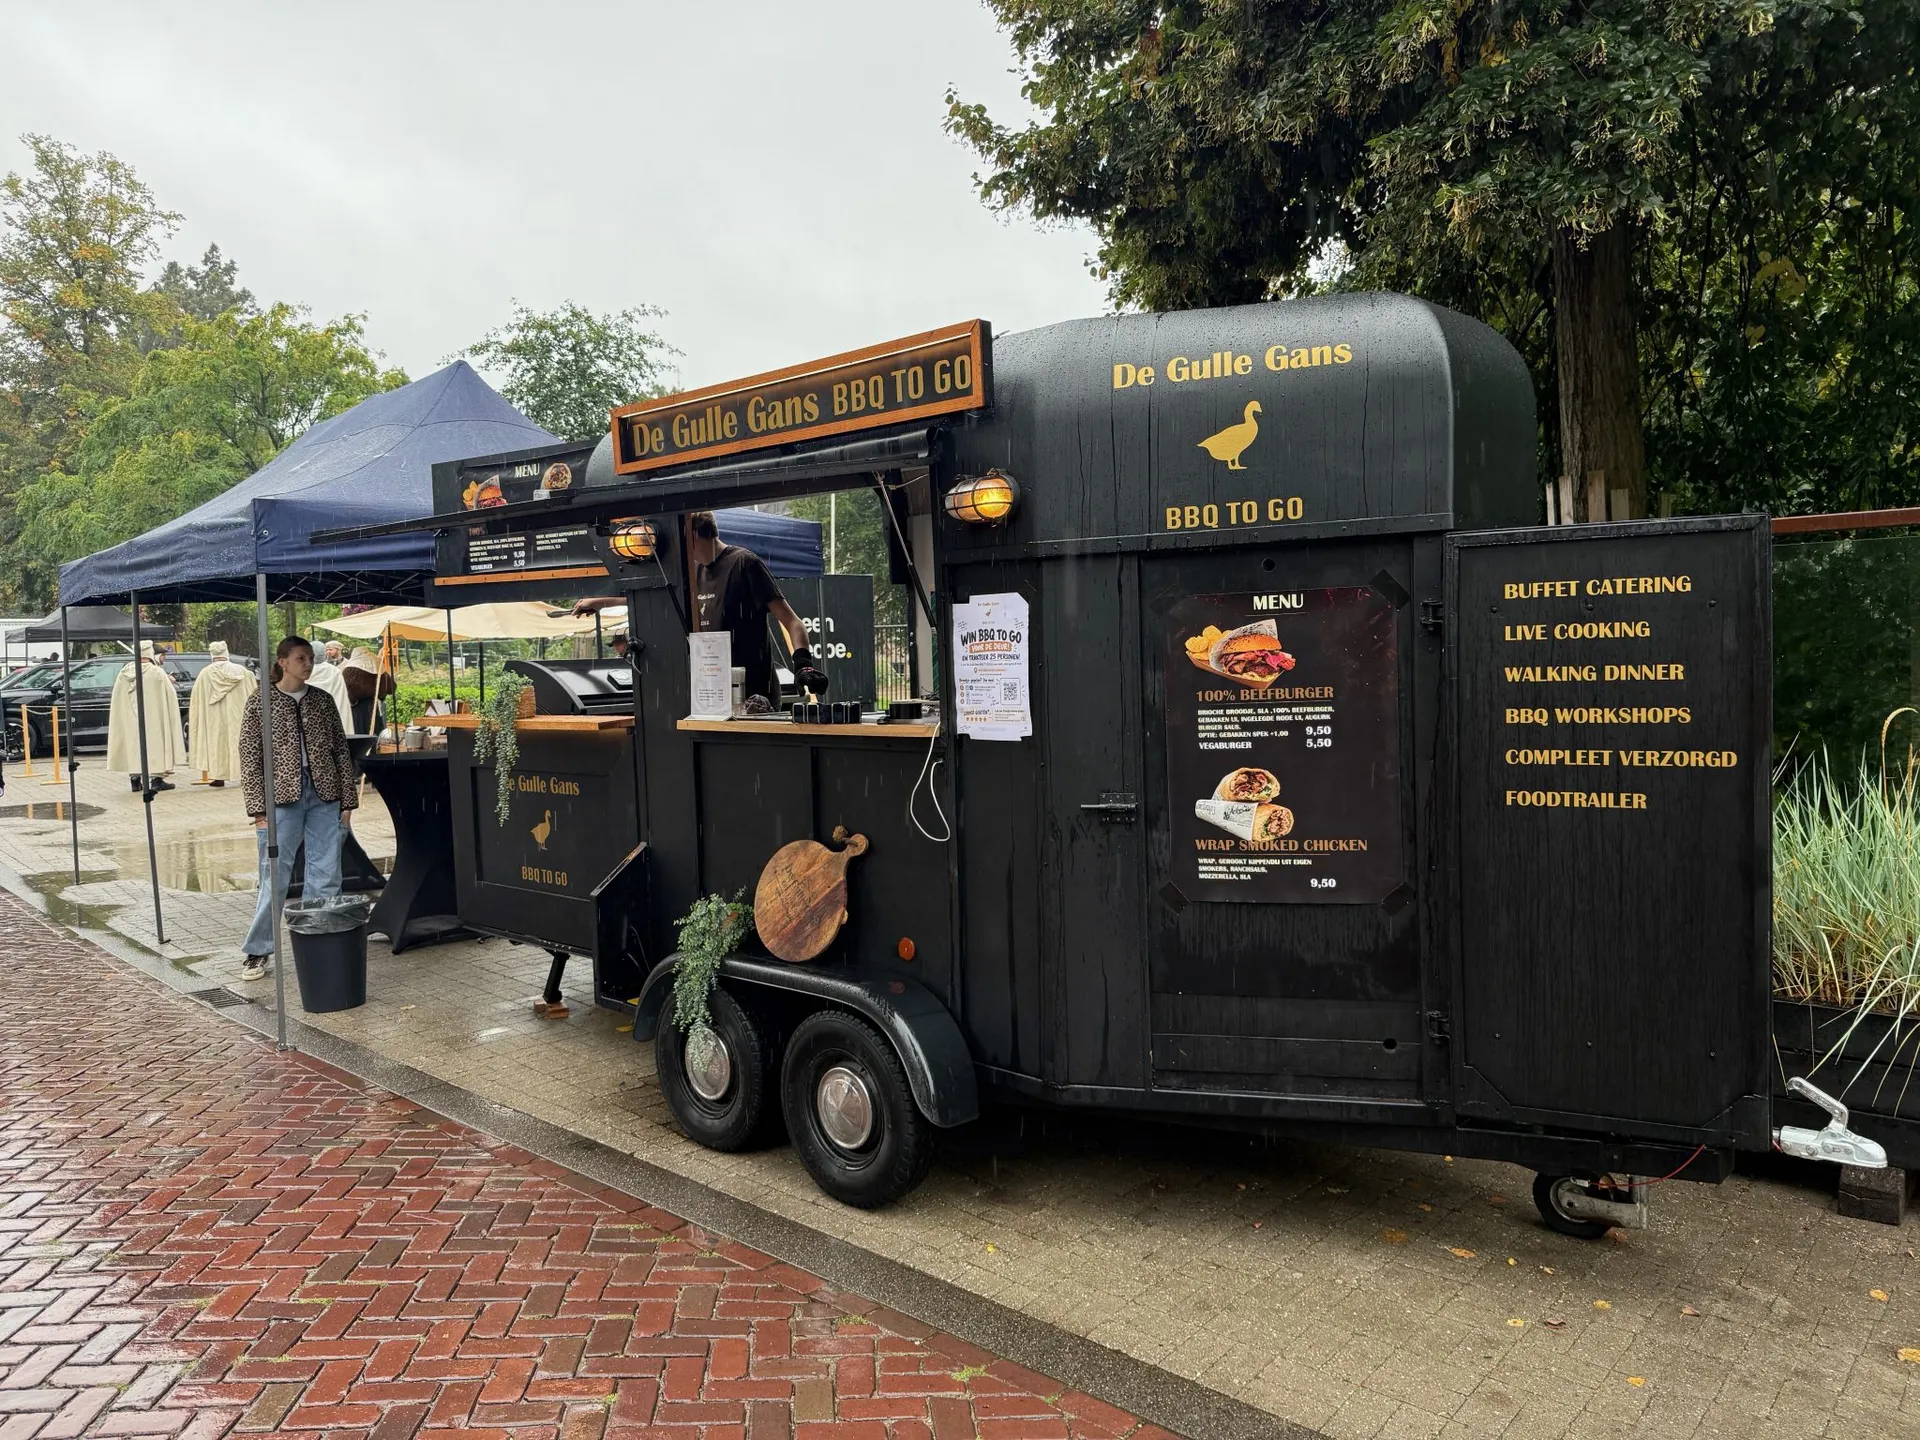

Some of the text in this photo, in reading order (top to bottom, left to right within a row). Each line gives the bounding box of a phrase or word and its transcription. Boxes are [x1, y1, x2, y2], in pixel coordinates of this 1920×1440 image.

[1113, 343, 1353, 389] De Gulle Gans
[633, 354, 971, 457] De Gulle Gans BBQ TO GO
[514, 463, 540, 478] MENU
[1166, 497, 1304, 530] BBQ TO GO
[1504, 575, 1693, 600] BUFFET CATERING
[1253, 593, 1304, 611] MENU
[960, 629, 1022, 647] WIN BBQ TO GO
[1504, 621, 1651, 641] LIVE COOKING
[1504, 663, 1685, 683] WALKING DINNER
[1196, 686, 1334, 702] 100% BEEFBURGER
[1275, 714, 1294, 722] RODE
[1505, 707, 1692, 727] BBQ WORKSHOPS
[1305, 726, 1332, 736] 9,50
[1199, 738, 1332, 750] VEGABURGER 5,50
[1505, 749, 1738, 768] COMPLEET VERZORGD
[518, 775, 547, 793] Gulle
[550, 777, 580, 796] Gans
[1505, 790, 1647, 809] FOODTRAILER
[1195, 839, 1368, 851] WRAP SMOKED CHICKEN
[521, 866, 568, 886] BBQ TO GO
[1310, 878, 1337, 889] 9,50
